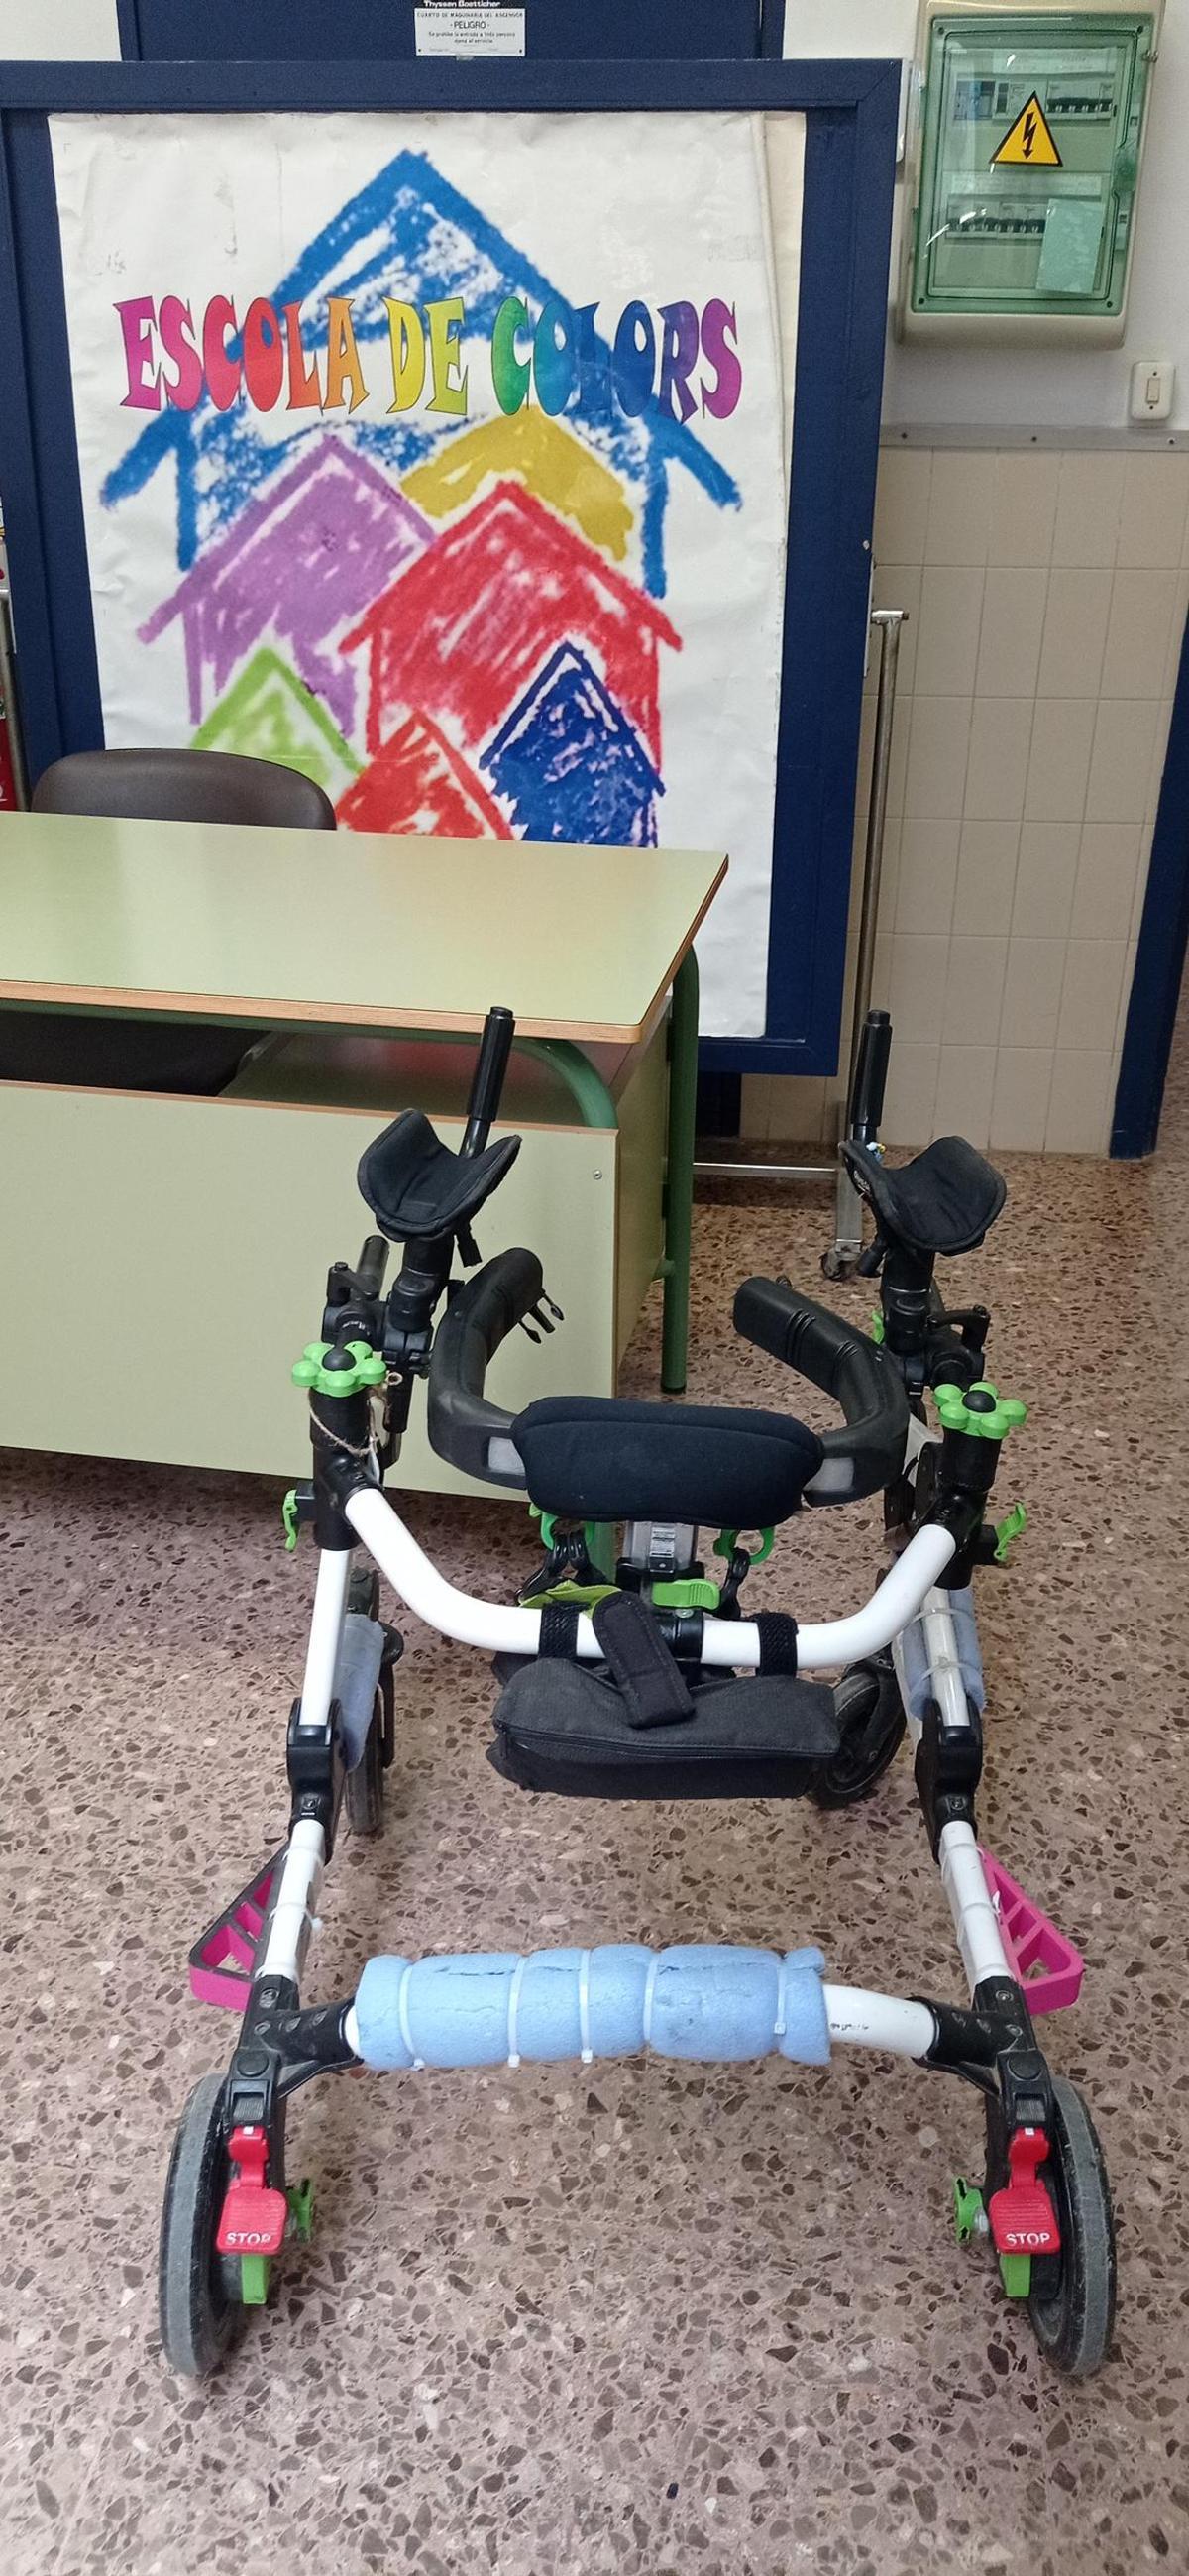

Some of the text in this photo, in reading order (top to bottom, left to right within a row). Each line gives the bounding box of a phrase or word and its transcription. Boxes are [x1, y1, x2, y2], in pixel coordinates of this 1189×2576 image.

[113, 295, 742, 424] ESCOLA DE COLORS
[226, 2232, 271, 2245] STOP
[1006, 2232, 1050, 2246] STOP
